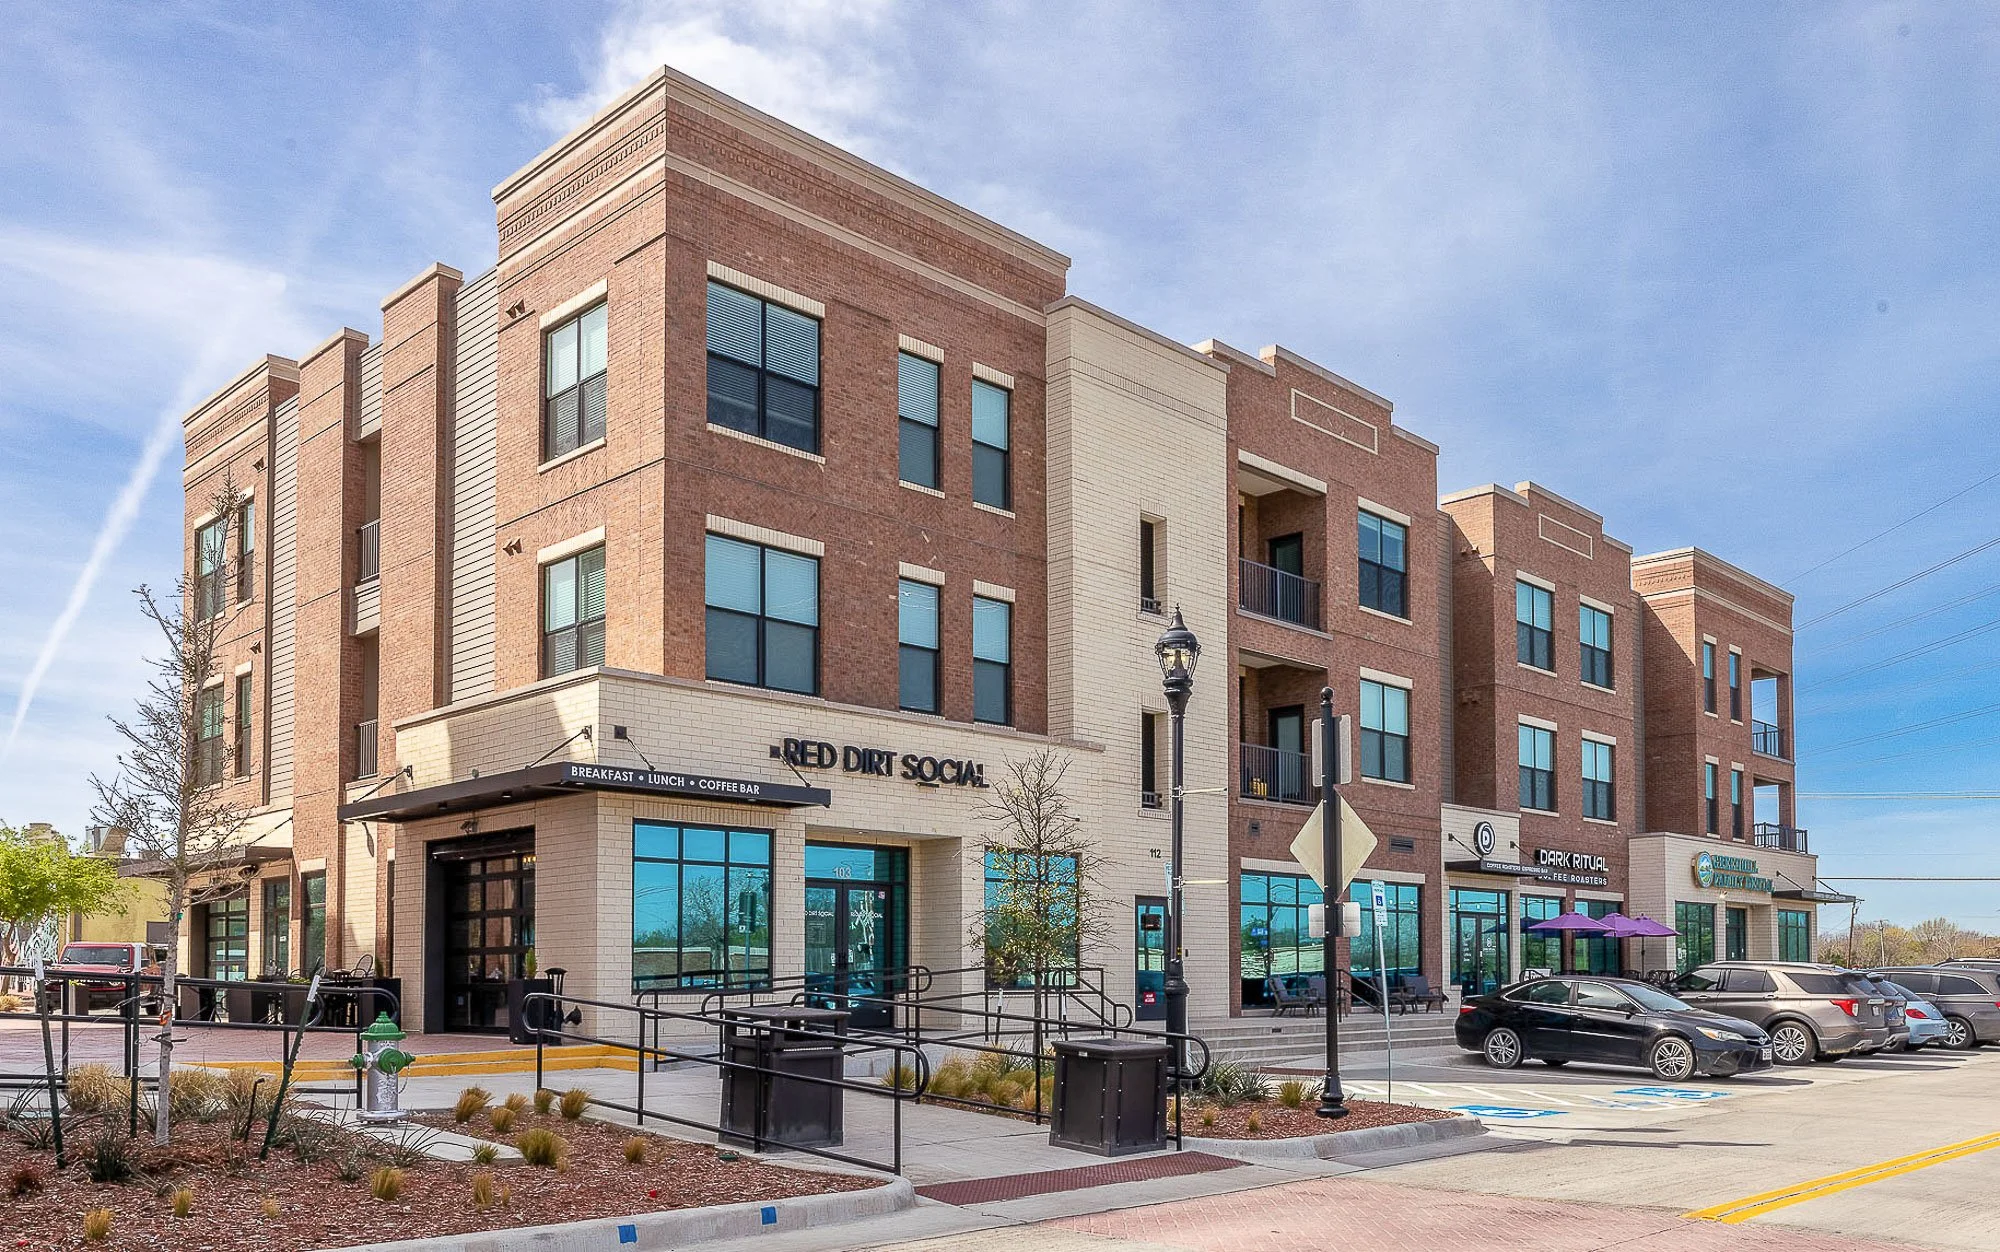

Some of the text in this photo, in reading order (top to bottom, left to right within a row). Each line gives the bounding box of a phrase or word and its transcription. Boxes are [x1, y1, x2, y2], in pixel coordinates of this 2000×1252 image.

[784, 737, 989, 788] RED DIRT SOCIAL
[571, 765, 760, 795] BREAKFAST LUNCH COFFEE BAR
[1150, 848, 1161, 858] 112
[1540, 849, 1609, 872] DARK RITUAL
[833, 867, 851, 879] 103
[1571, 874, 1607, 886] ROASTERS
